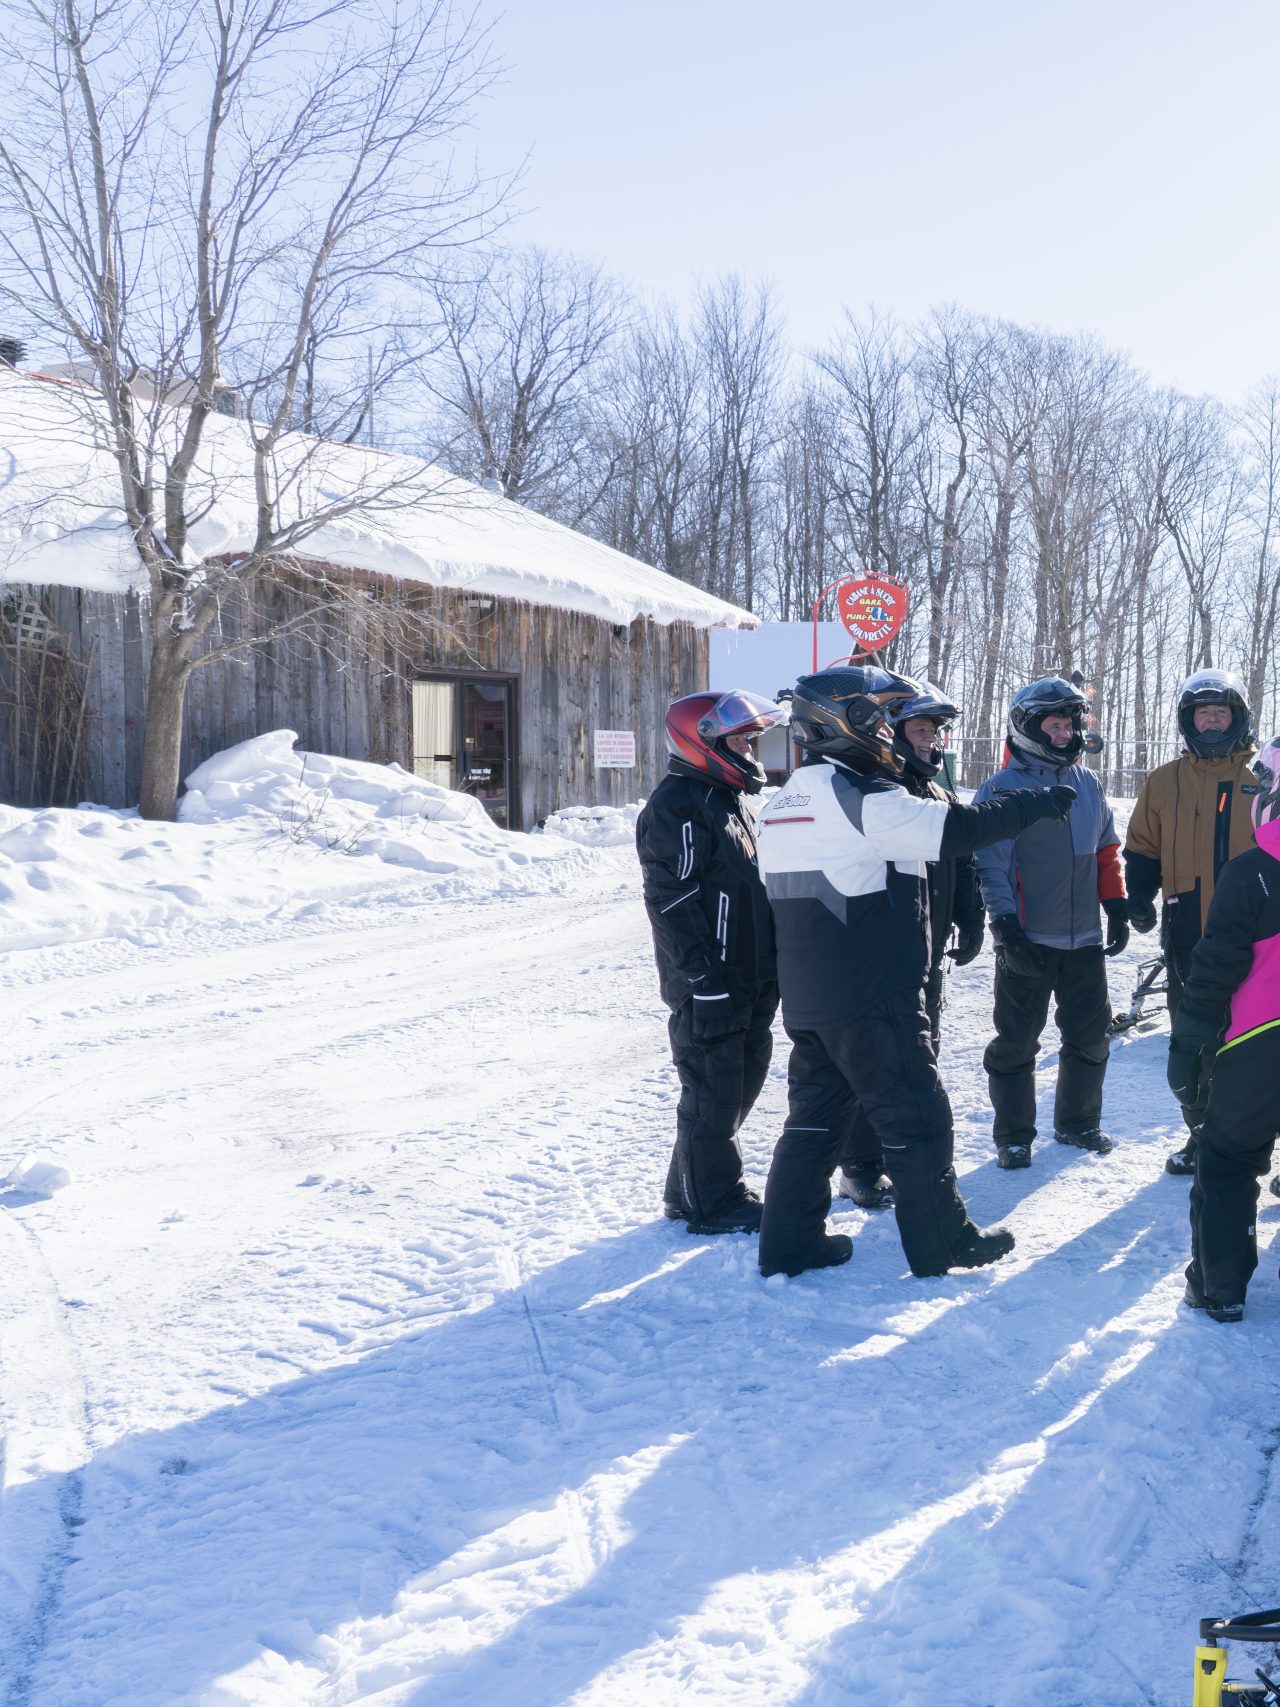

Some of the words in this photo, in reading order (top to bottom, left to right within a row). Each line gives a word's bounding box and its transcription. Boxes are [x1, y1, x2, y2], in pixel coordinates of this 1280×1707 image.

[845, 586, 868, 605] CABANE
[870, 584, 875, 595] À
[875, 587, 896, 606] SUCRE
[859, 598, 882, 606] GARE
[848, 623, 893, 641] BOUVRETTE
